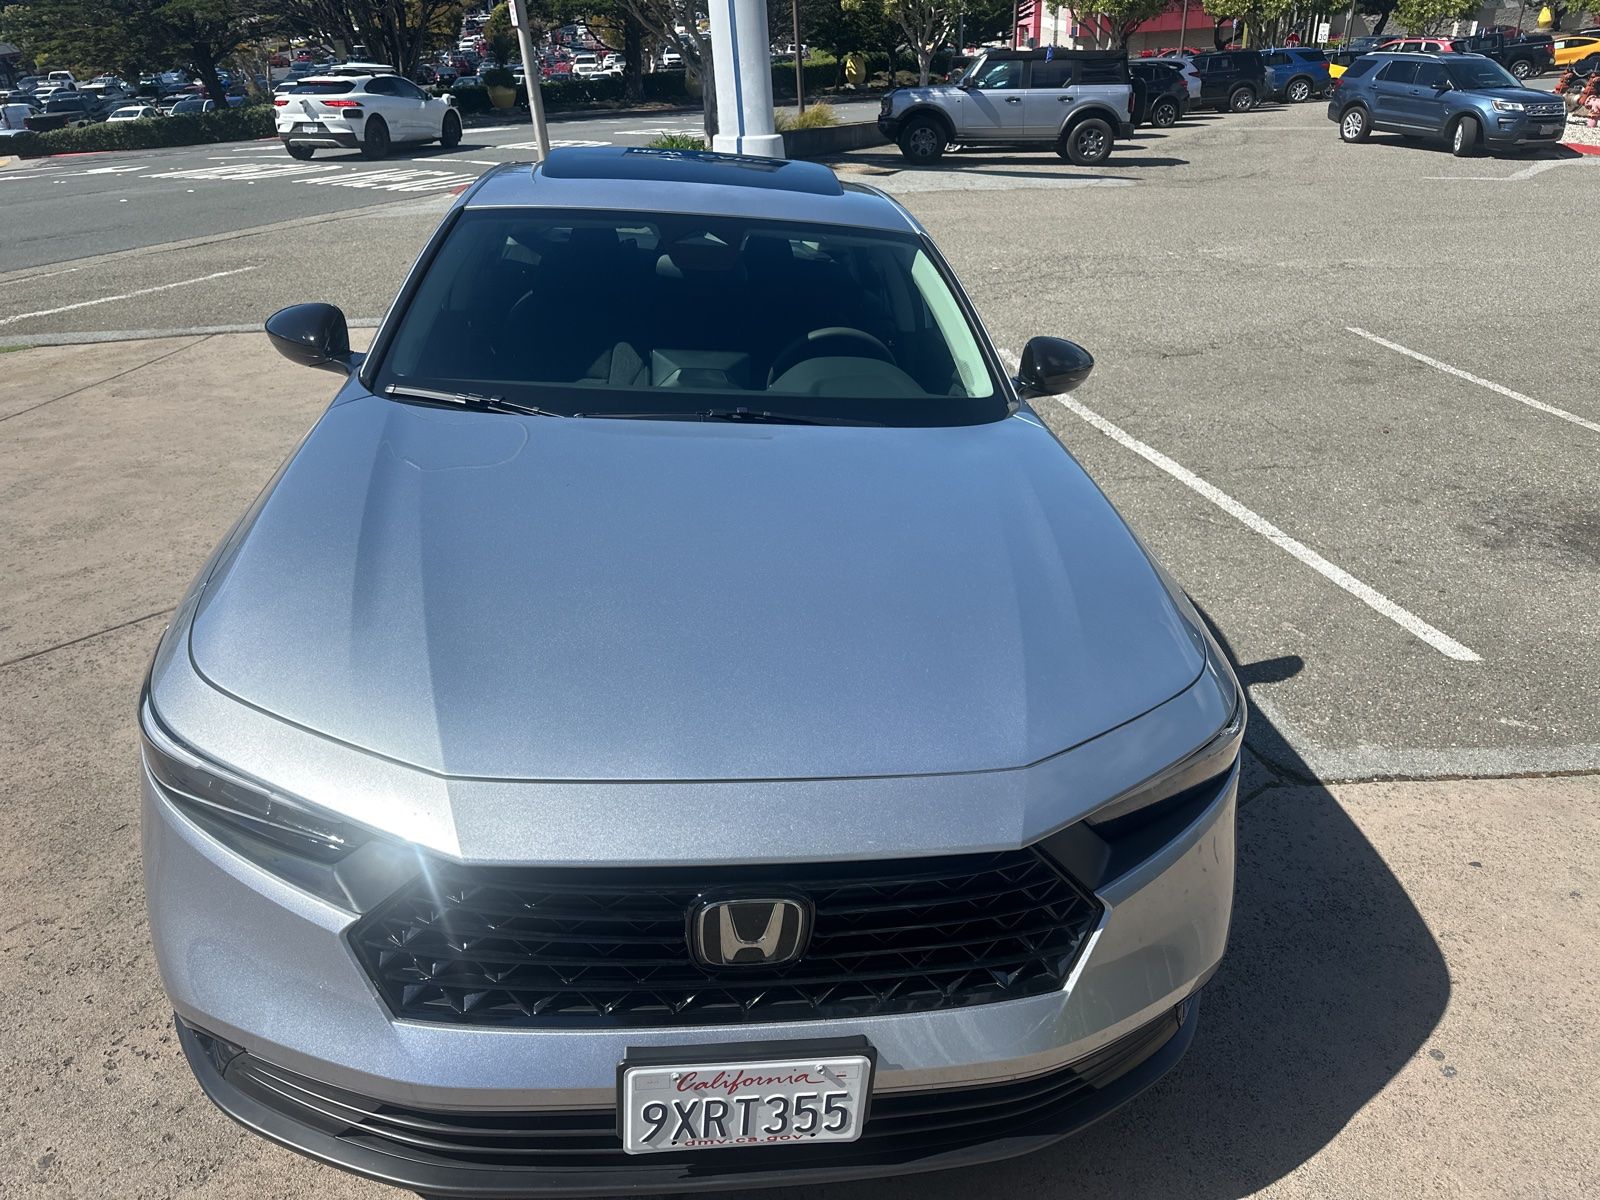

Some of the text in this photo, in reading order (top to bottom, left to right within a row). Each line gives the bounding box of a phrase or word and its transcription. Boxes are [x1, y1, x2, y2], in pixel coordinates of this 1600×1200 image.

[676, 1071, 825, 1095] California
[639, 1094, 849, 1143] 9XRT355
[684, 1133, 804, 1147] dmv.ca.gov
